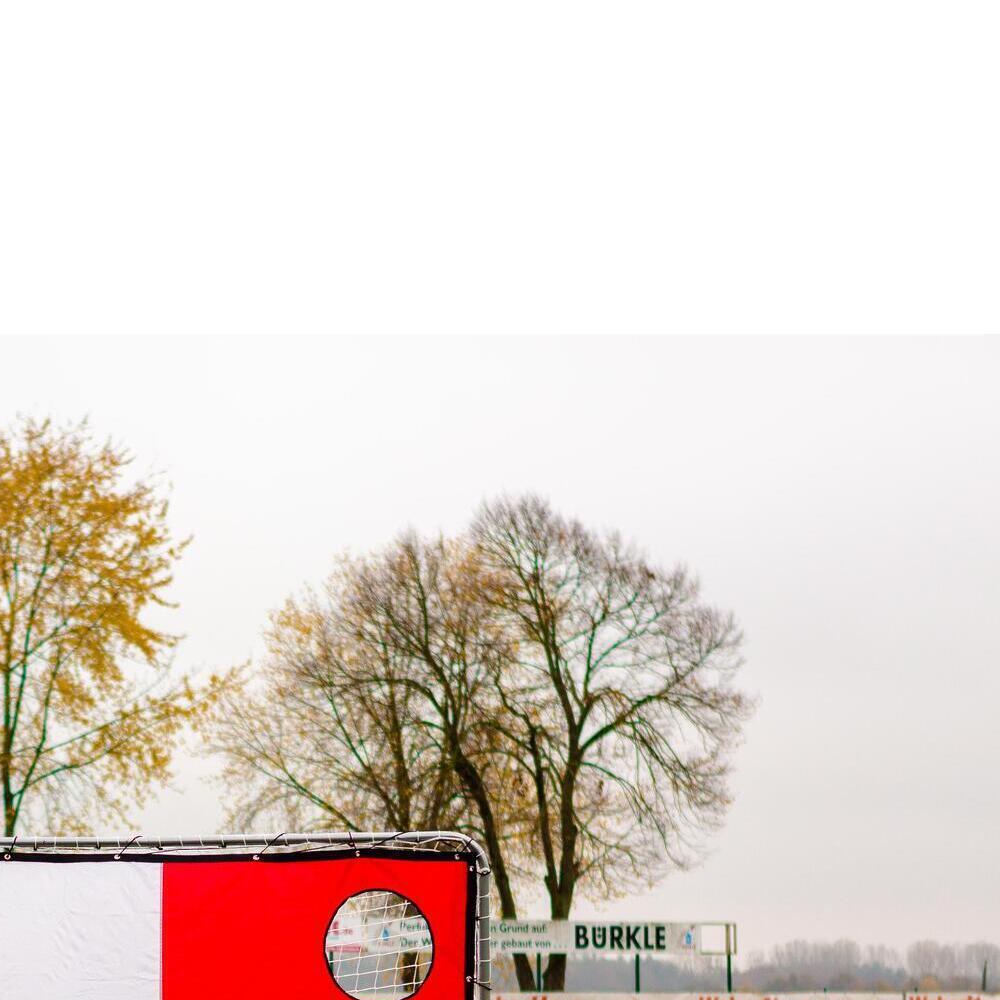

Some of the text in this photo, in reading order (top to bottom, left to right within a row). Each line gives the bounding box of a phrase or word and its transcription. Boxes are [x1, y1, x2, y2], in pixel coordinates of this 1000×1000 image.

[500, 923, 529, 933] Grund
[575, 924, 666, 950] BÜRKLE
[501, 939, 532, 949] gebaut
[535, 941, 551, 949] von
